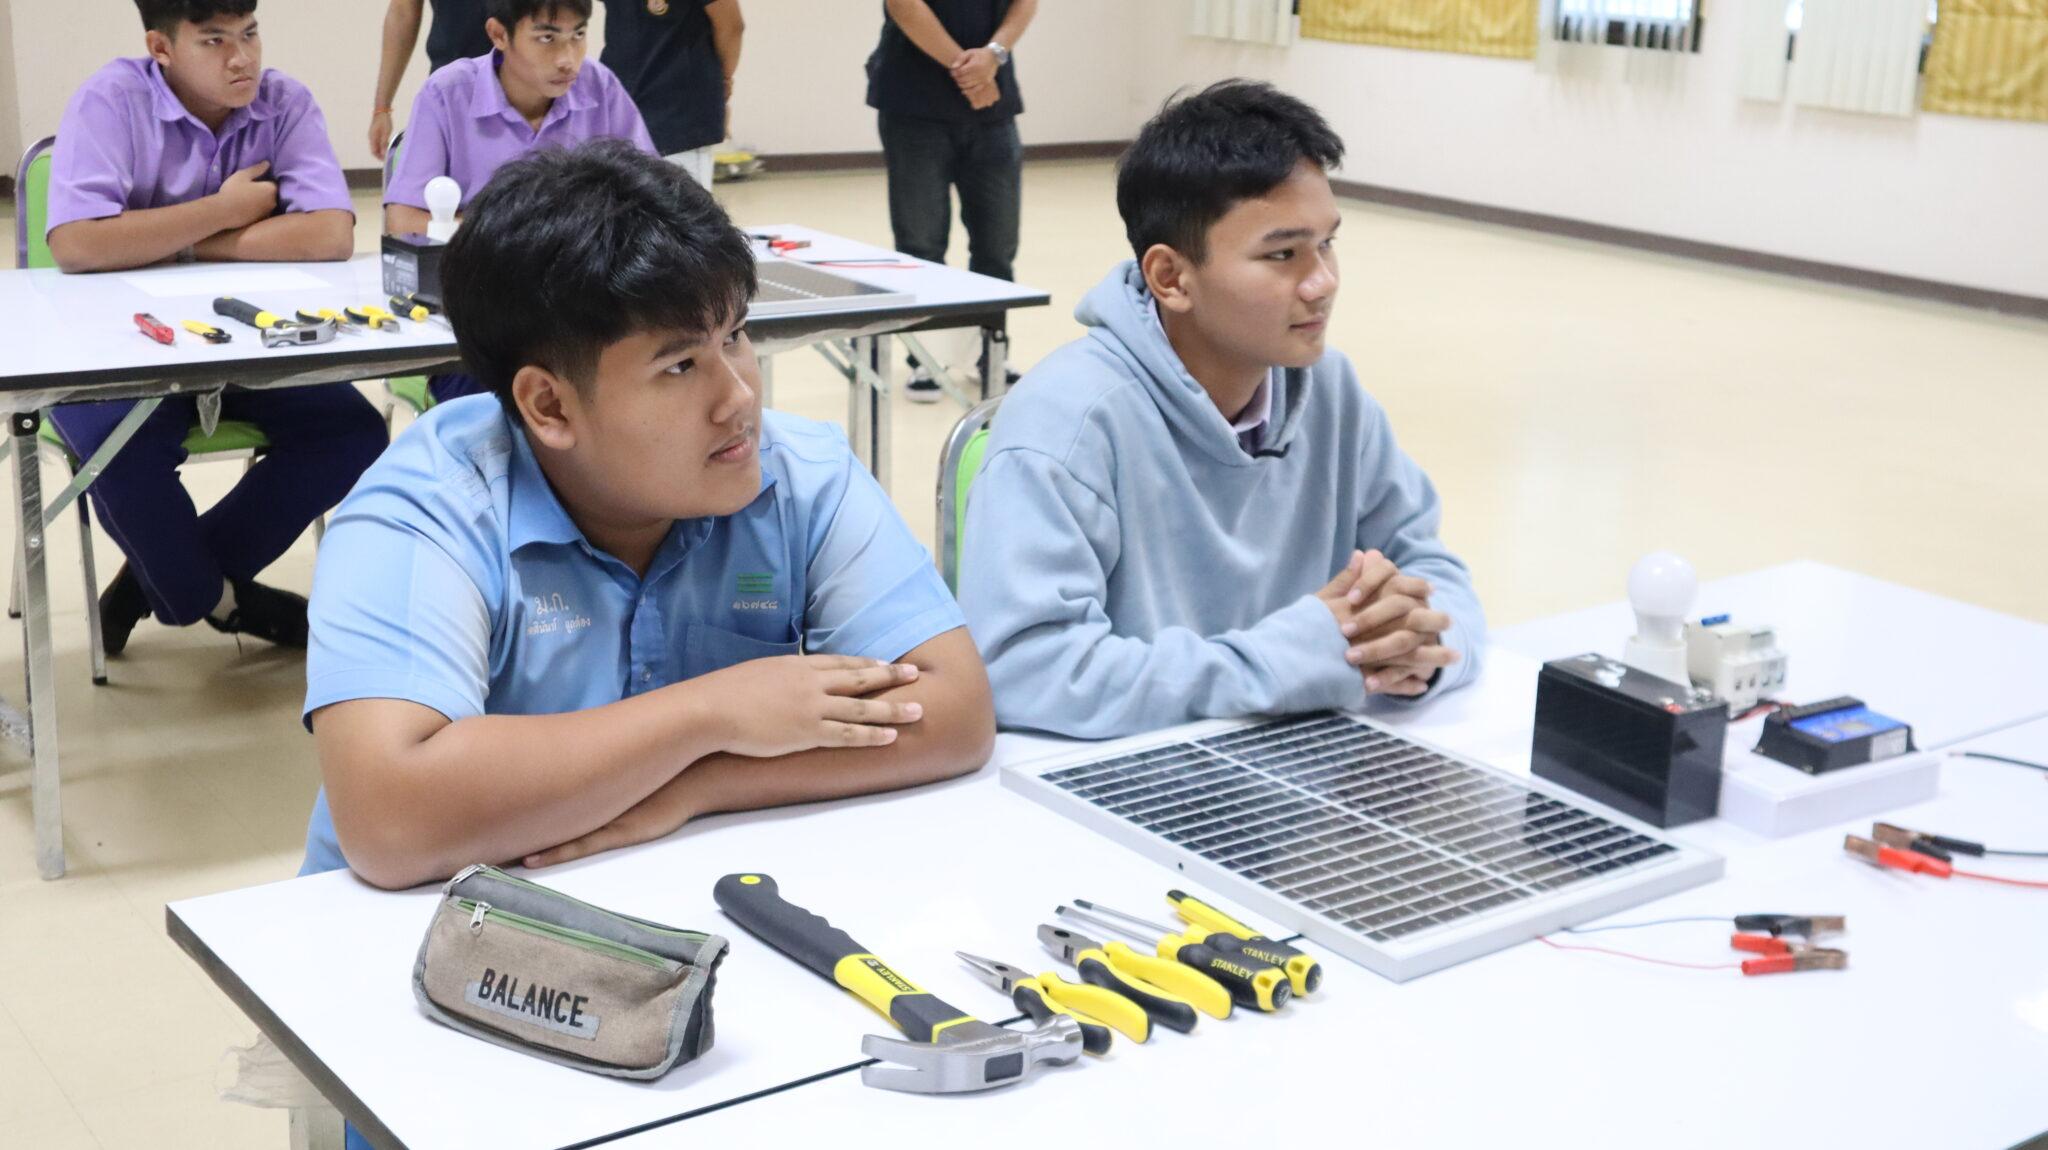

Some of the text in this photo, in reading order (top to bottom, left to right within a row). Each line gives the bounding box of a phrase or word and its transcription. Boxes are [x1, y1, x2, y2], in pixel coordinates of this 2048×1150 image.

[1242, 947, 1286, 966] STANLEY
[1210, 959, 1254, 980] STANLEY
[478, 967, 589, 1028] BALANCE
